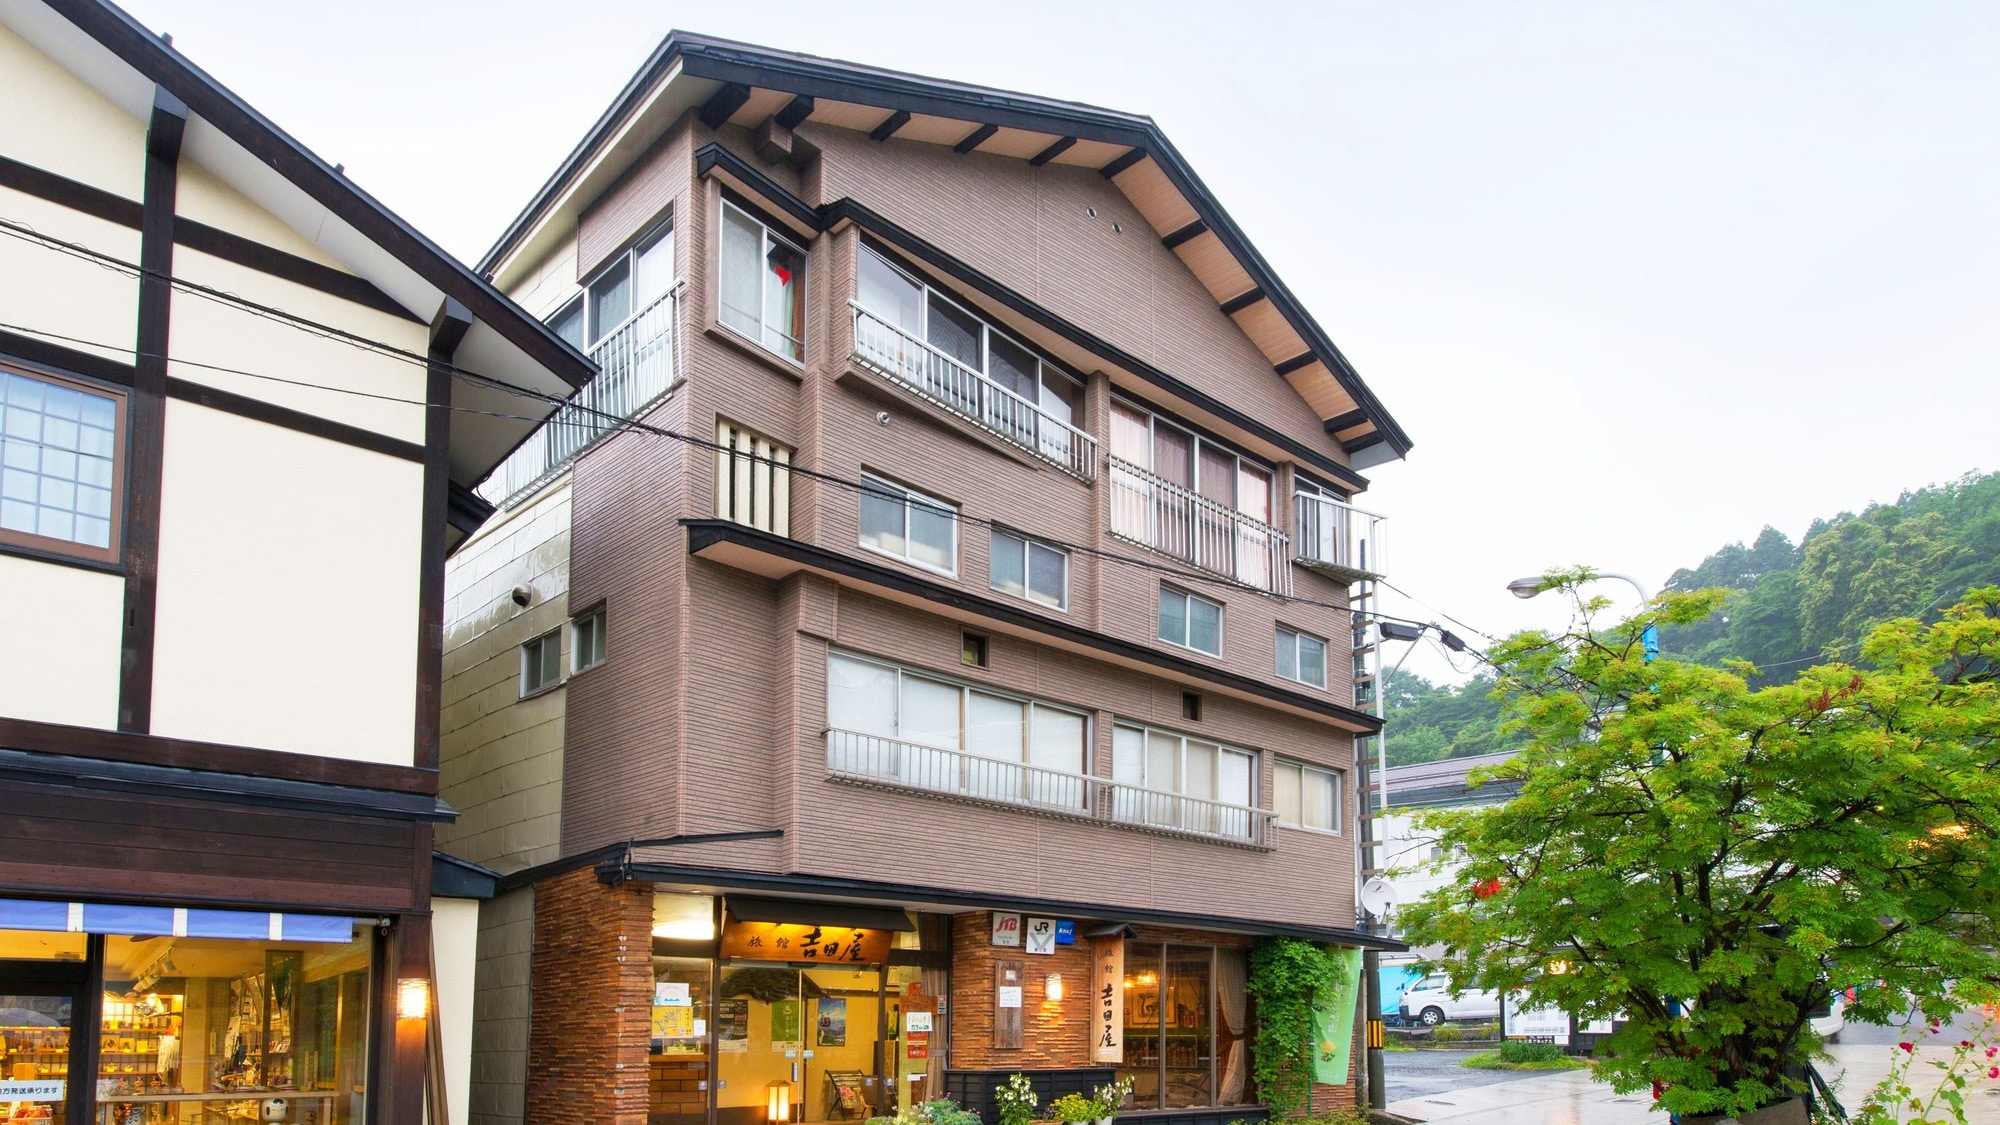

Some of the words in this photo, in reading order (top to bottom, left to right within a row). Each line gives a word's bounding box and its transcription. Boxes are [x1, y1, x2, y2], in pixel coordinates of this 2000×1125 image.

[995, 917, 1018, 933] JTB
[1034, 922, 1049, 932] JR
[747, 936, 790, 949] 旅館
[800, 927, 866, 961] 吉田屋
[1104, 948, 1114, 974] 旅館
[1099, 983, 1117, 1048] 吉田屋
